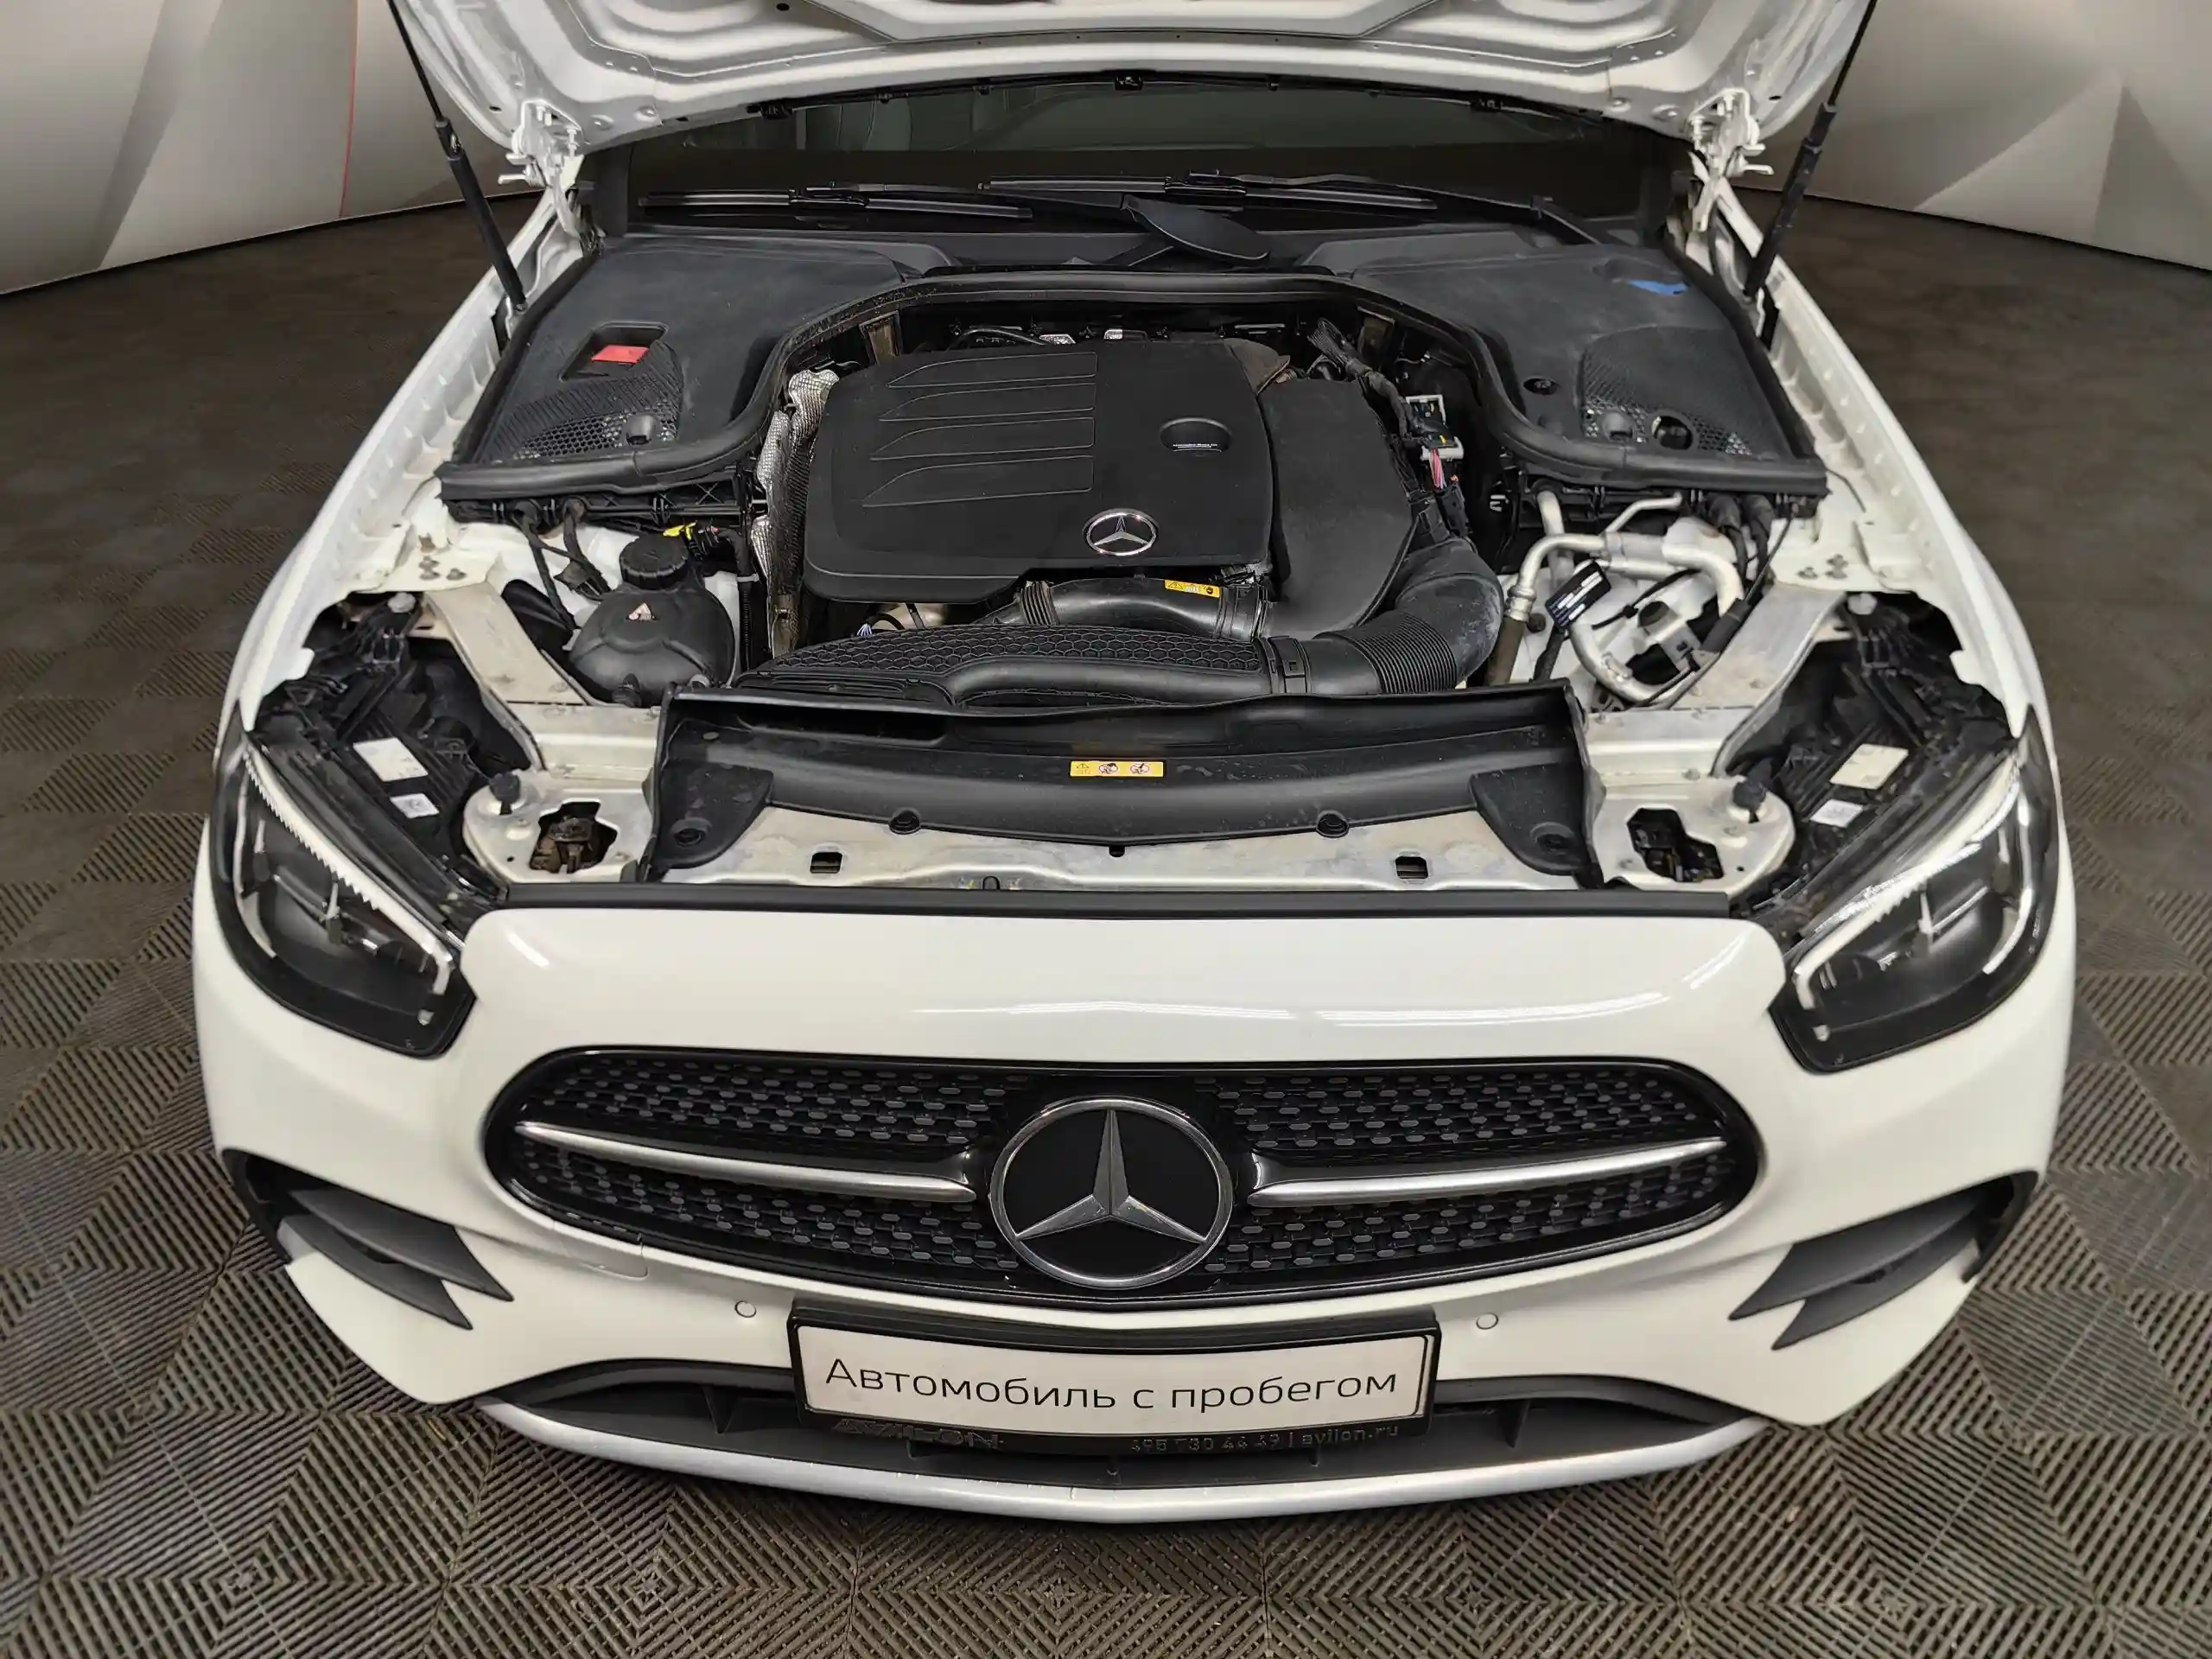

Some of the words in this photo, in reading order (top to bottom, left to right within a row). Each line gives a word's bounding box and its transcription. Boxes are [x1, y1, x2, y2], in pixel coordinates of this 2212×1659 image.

[825, 1357, 1116, 1408] Автомобиль
[1133, 1389, 1154, 1409] с
[1172, 1373, 1397, 1414] пробегом
[1301, 1425, 1400, 1446] avilon.ru
